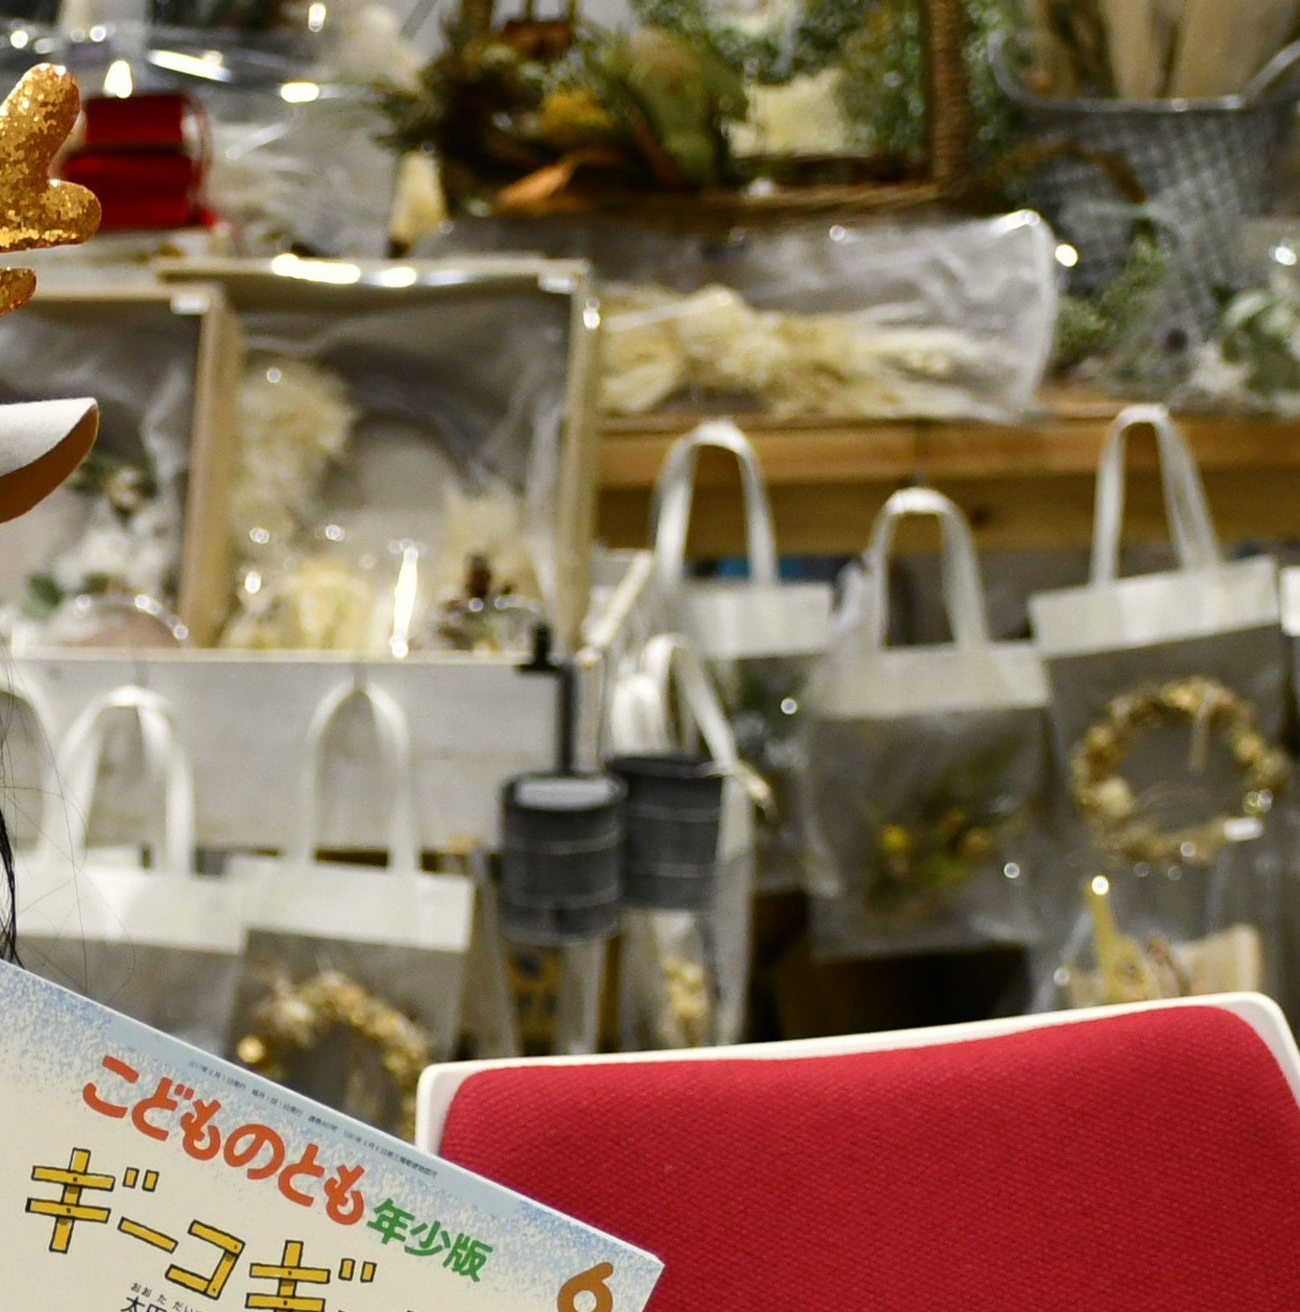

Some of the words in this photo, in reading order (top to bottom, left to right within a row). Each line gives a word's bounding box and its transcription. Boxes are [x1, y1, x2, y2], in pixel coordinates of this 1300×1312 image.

[81, 1055, 366, 1226] こどものとも
[367, 1198, 495, 1284] 年少版
